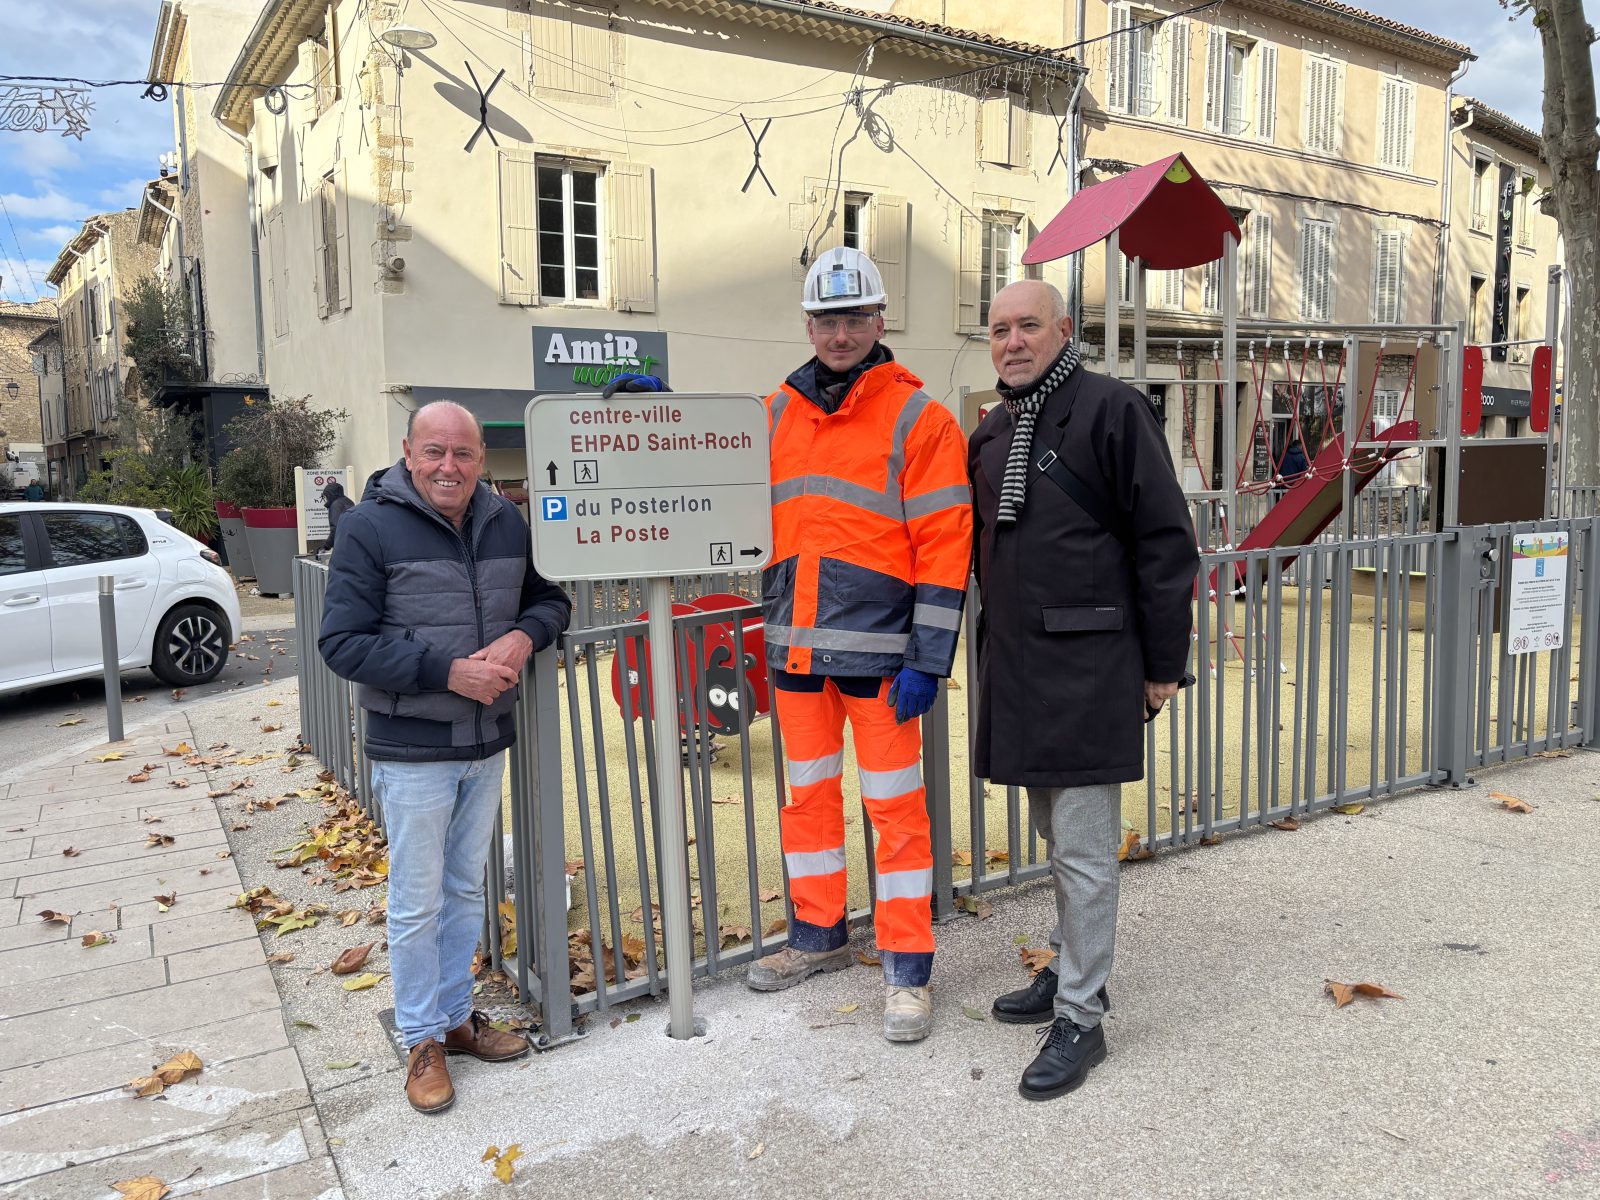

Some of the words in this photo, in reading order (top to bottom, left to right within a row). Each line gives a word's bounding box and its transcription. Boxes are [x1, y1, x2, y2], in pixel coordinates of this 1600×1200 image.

[544, 332, 640, 366] AmiR
[569, 405, 682, 425] centre-ville
[570, 433, 640, 453] EHPAD
[647, 431, 752, 452] Saint-Roch
[546, 498, 563, 519] P
[575, 498, 601, 517] du
[576, 526, 601, 544] La
[611, 524, 670, 543] Poste
